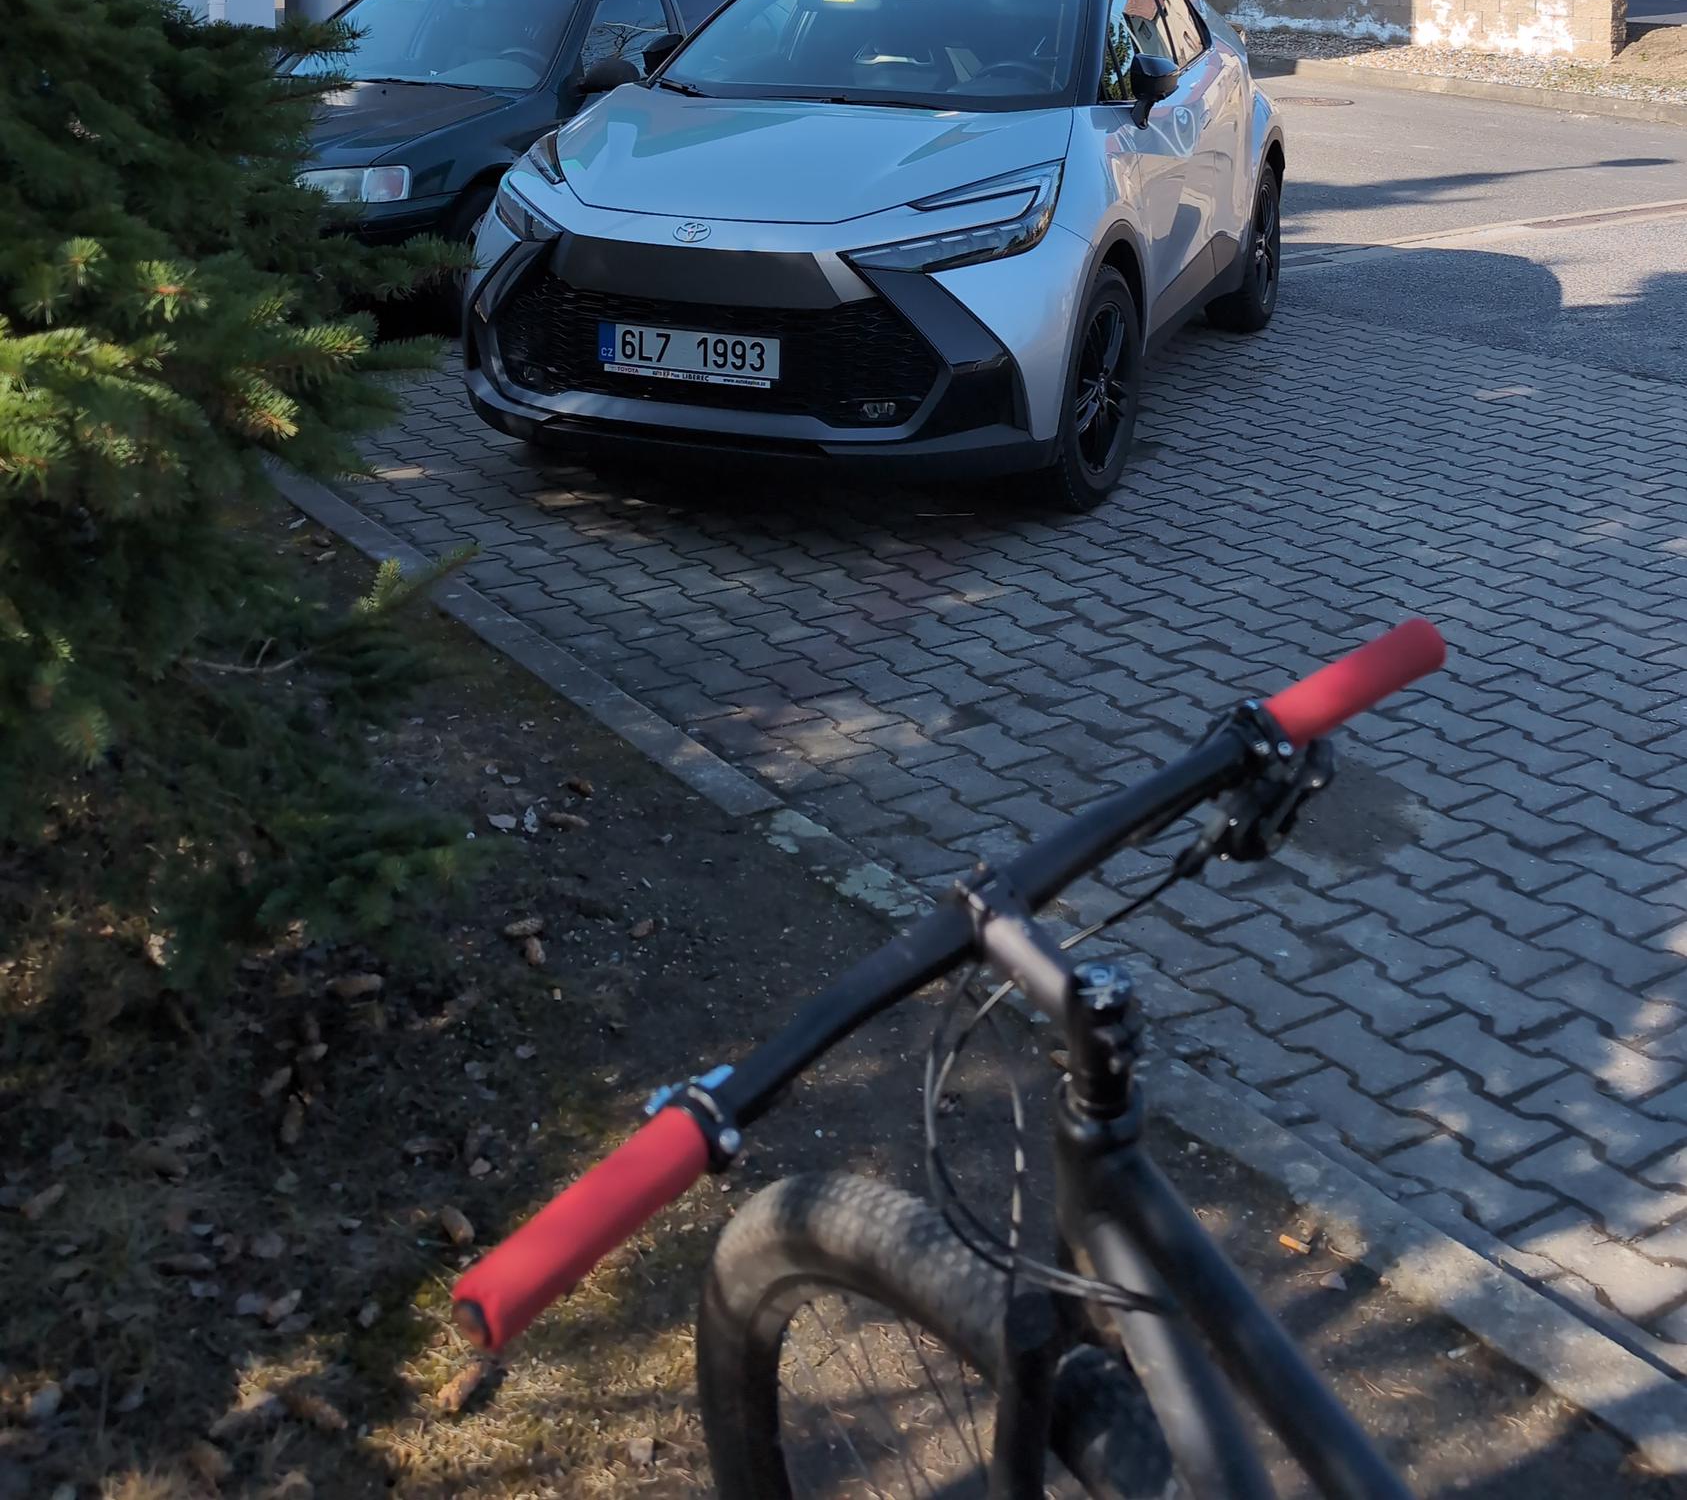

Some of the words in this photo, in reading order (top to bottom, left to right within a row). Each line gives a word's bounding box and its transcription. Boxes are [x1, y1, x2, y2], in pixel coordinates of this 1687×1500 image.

[601, 347, 614, 358] CZ
[621, 329, 671, 363] 6L7
[696, 337, 766, 373] 1993
[617, 366, 639, 374] TOYOTA
[682, 373, 710, 382] LIBEREC
